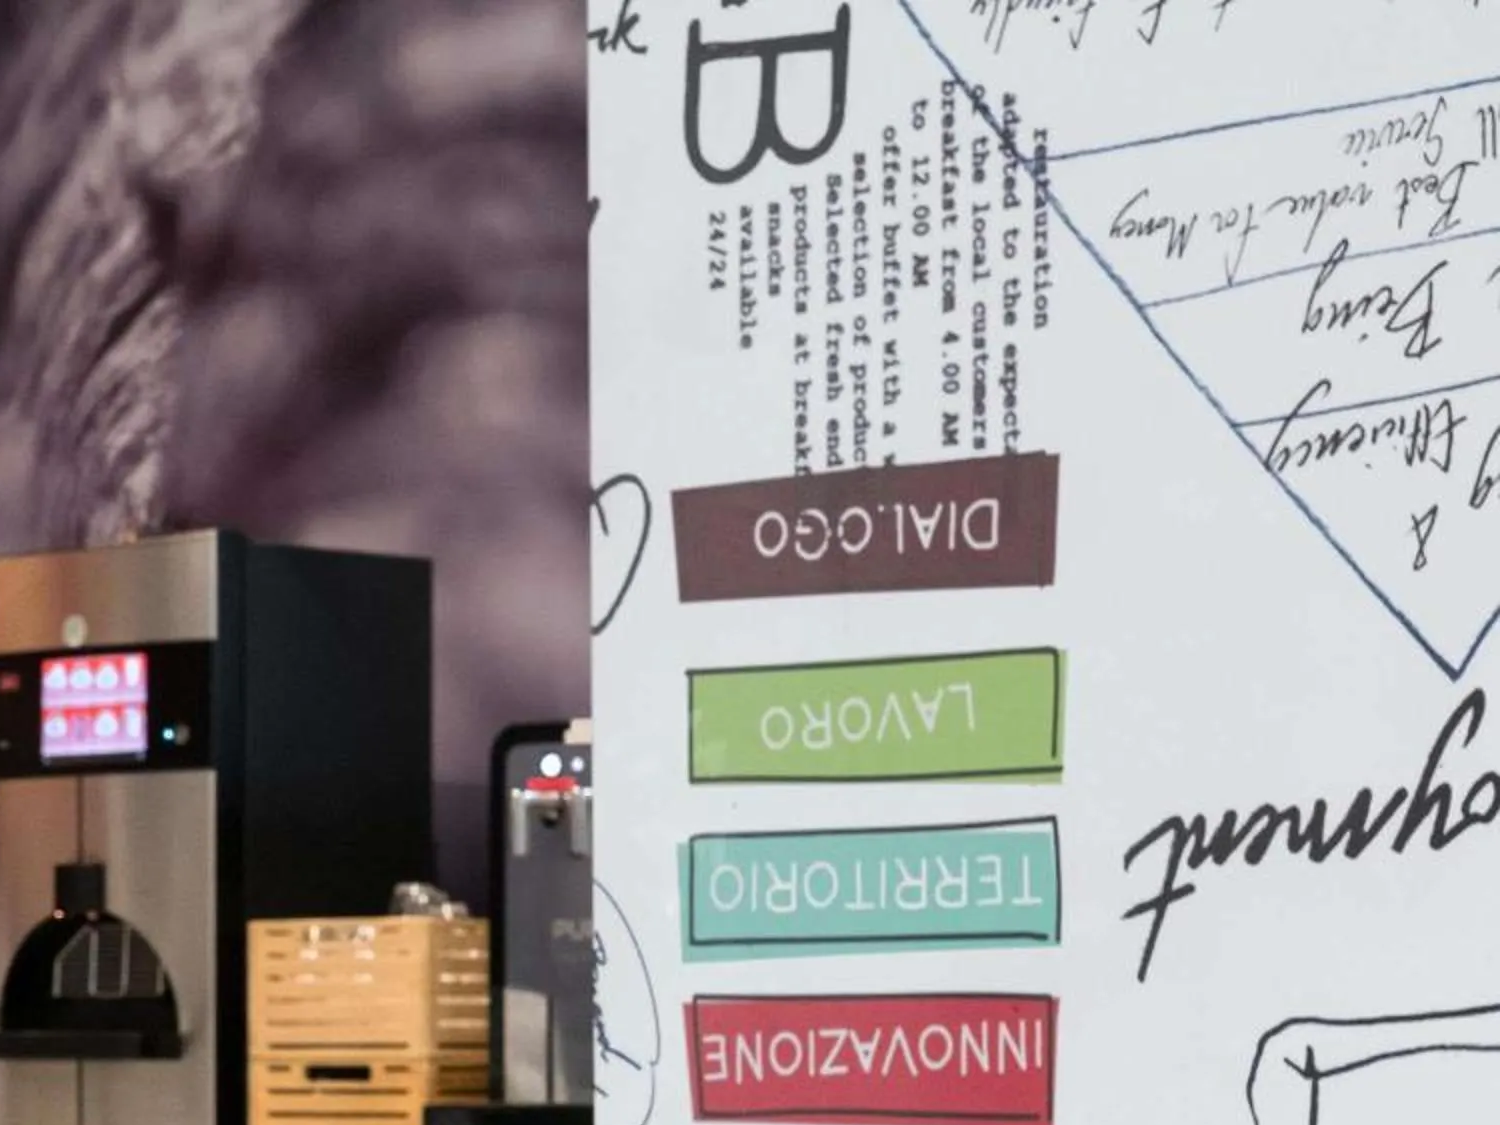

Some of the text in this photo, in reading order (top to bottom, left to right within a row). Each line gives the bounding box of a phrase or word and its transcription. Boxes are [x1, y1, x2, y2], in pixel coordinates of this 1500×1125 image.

[683, 2, 851, 185] B
[883, 126, 901, 206] offer
[972, 136, 990, 184] the
[998, 93, 1022, 209] adapted
[912, 100, 930, 287] to 12.00 AM
[1034, 128, 1053, 330] restauration
[1108, 188, 1198, 260] Money
[1395, 161, 1480, 237] Best
[708, 212, 726, 290] 24/24
[740, 206, 757, 349] available
[767, 203, 784, 297] snacks
[790, 186, 812, 314] products
[883, 224, 901, 323] buffet
[941, 80, 960, 446] breakfast from 4.00 AM
[972, 204, 990, 282] local
[1003, 228, 1020, 259] to
[1211, 203, 1260, 287] for
[826, 174, 844, 468] Selected fresh end
[849, 153, 871, 470] selection of produc
[1003, 278, 1021, 326] the
[1301, 238, 1449, 359] Being
[795, 334, 810, 364] at
[883, 340, 901, 405] with
[972, 302, 990, 449] customers
[883, 422, 896, 436] a
[1264, 379, 1468, 474] Efficiency
[754, 498, 999, 560] DIALOGO
[760, 681, 976, 750] LAVORO
[709, 854, 1043, 913] TERRITORIO
[702, 1018, 1043, 1085] INNOVAZIONE
